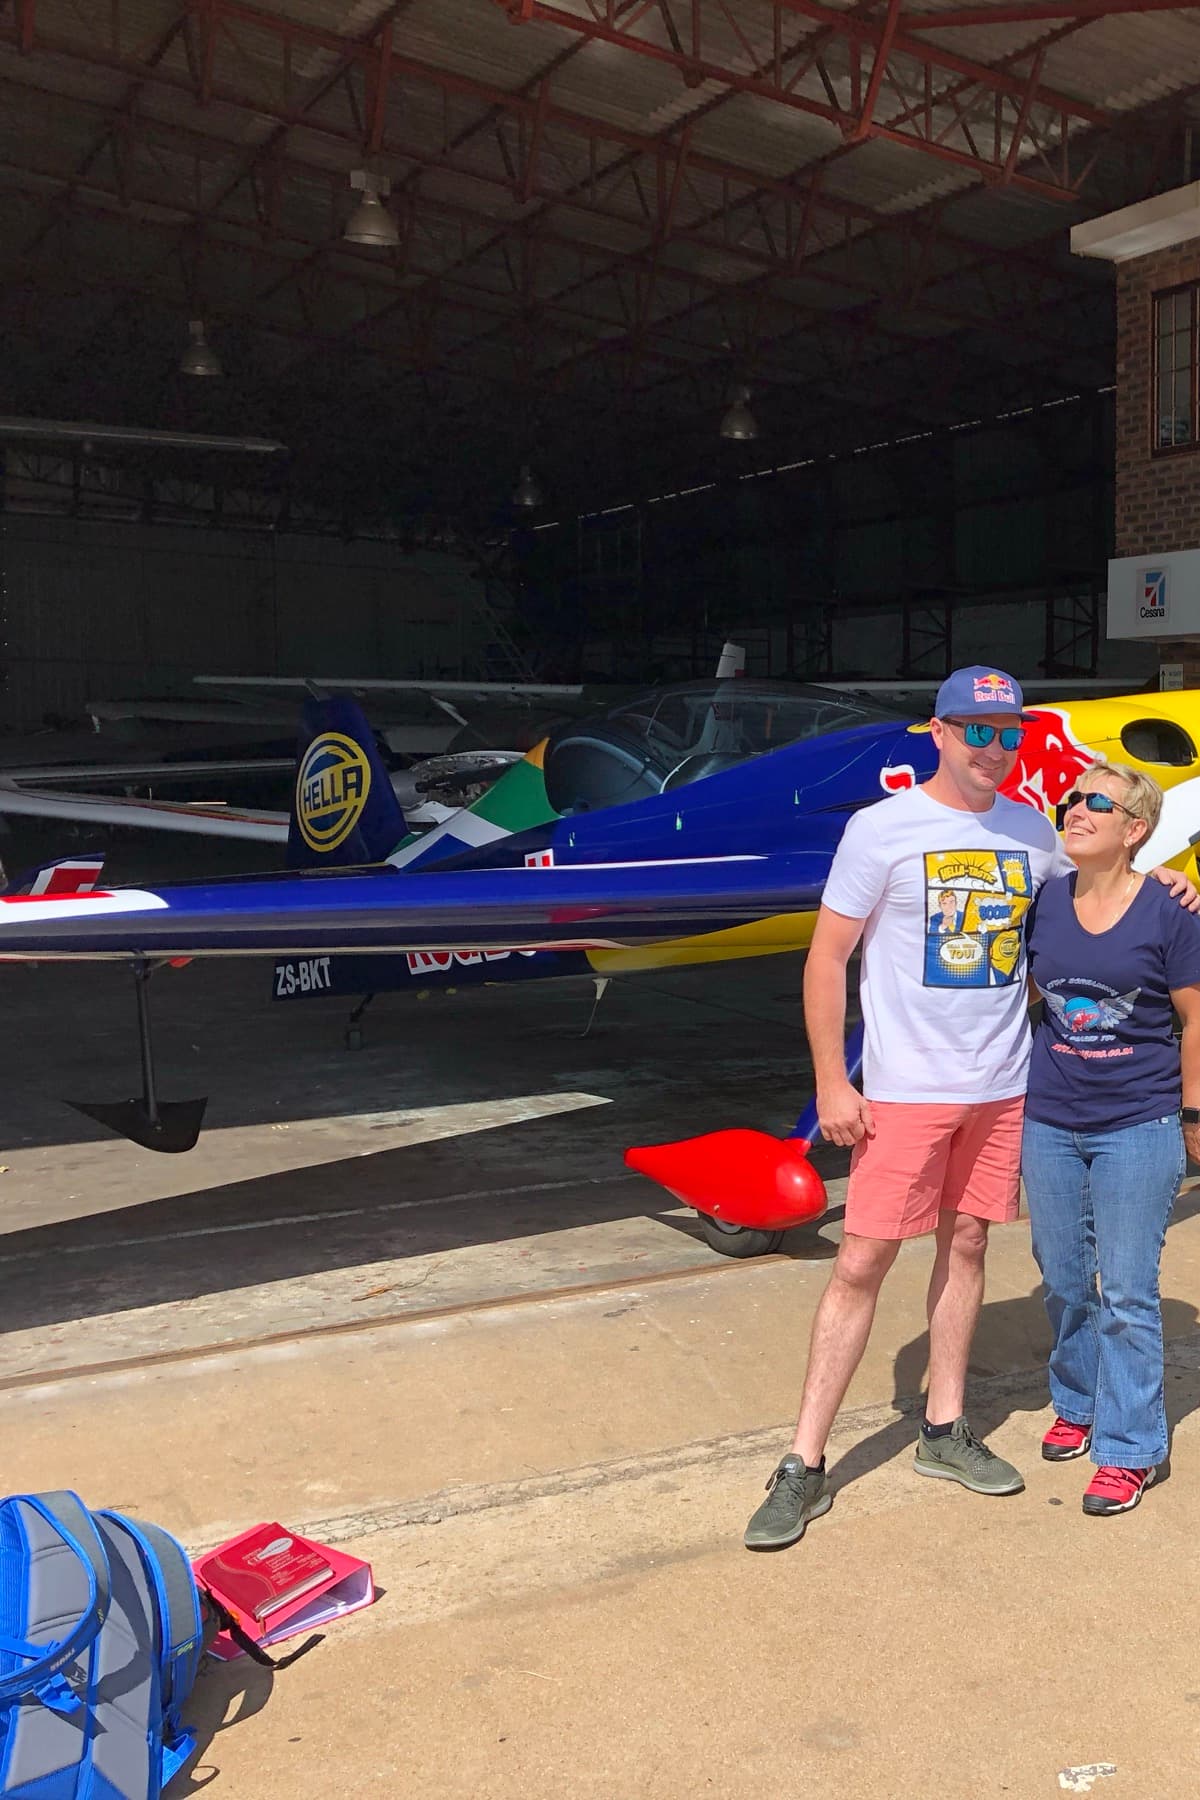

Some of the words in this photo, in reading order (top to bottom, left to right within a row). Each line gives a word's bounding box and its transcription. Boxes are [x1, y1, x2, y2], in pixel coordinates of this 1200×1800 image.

[1140, 607, 1165, 618] Cessna
[974, 690, 997, 702] Red
[997, 690, 1015, 704] Bull
[303, 765, 363, 813] HELLA
[275, 957, 331, 996] ZS-BKT
